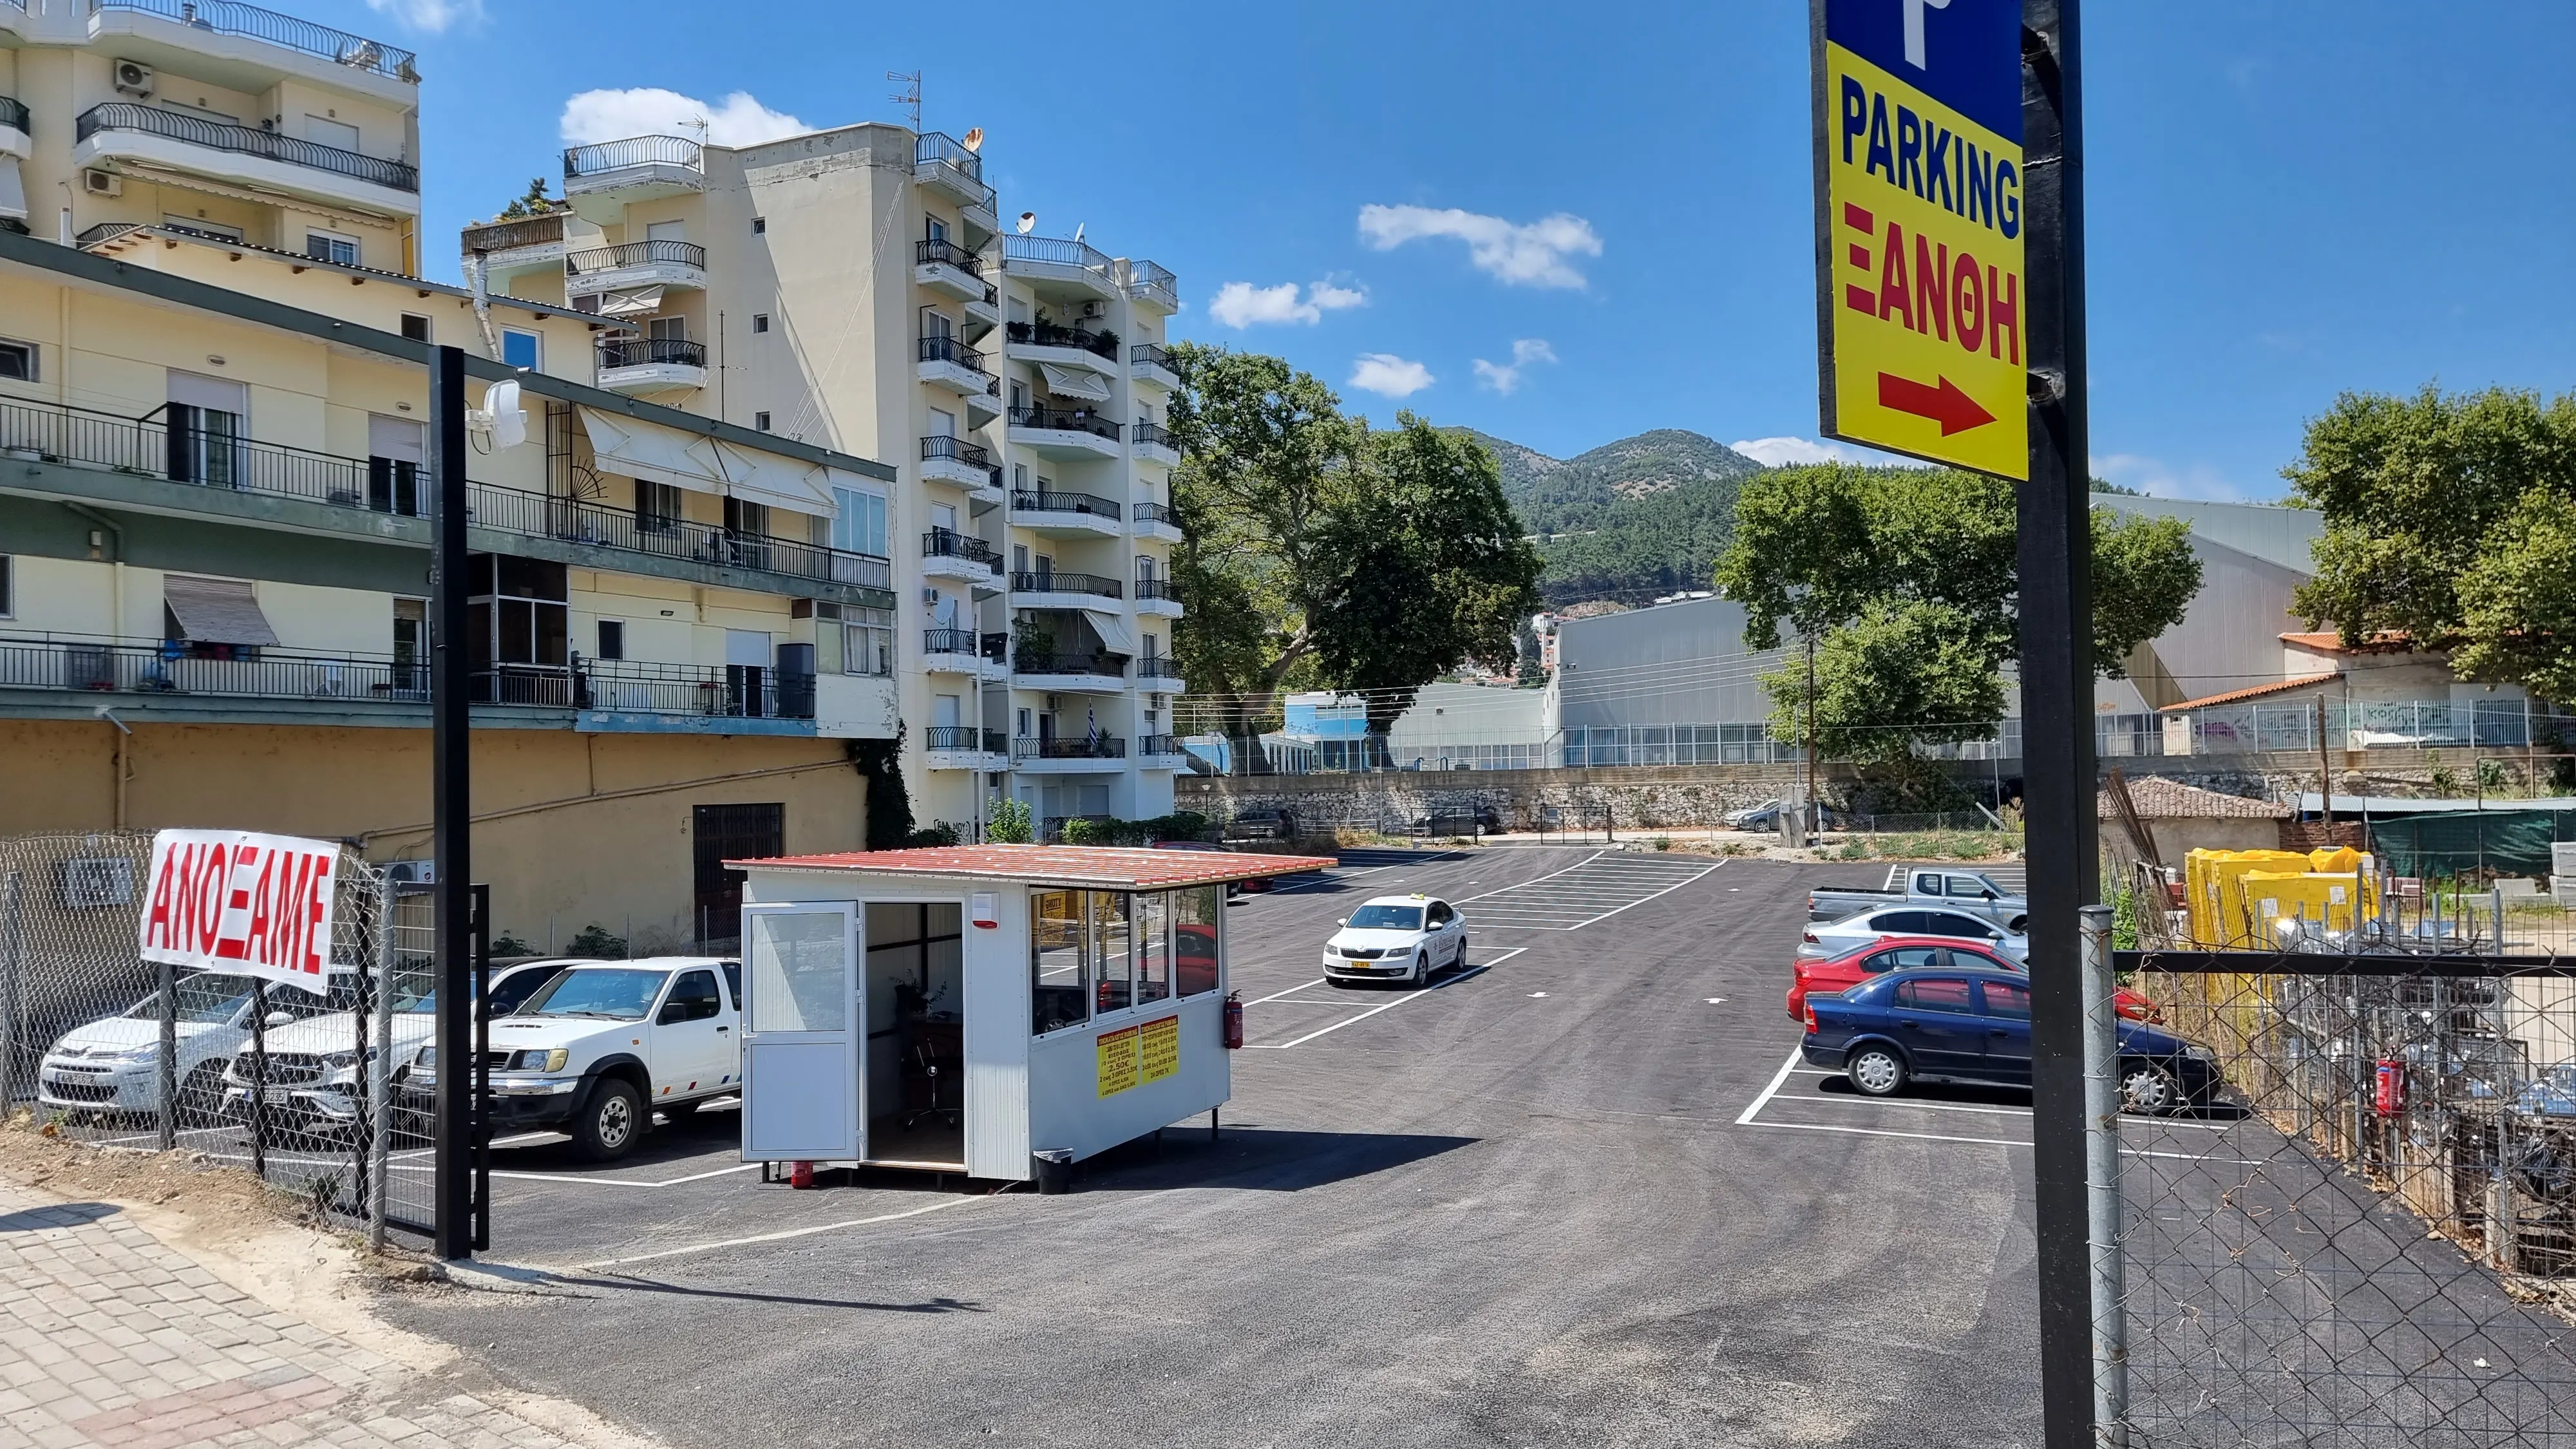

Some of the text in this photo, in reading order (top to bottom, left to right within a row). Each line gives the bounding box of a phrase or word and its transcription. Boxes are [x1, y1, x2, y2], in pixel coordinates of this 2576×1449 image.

[1841, 73, 2020, 240] PARKING
[1844, 201, 2019, 366] ΞΑΝΘΗ
[1108, 1060, 1130, 1072] 2.50€
